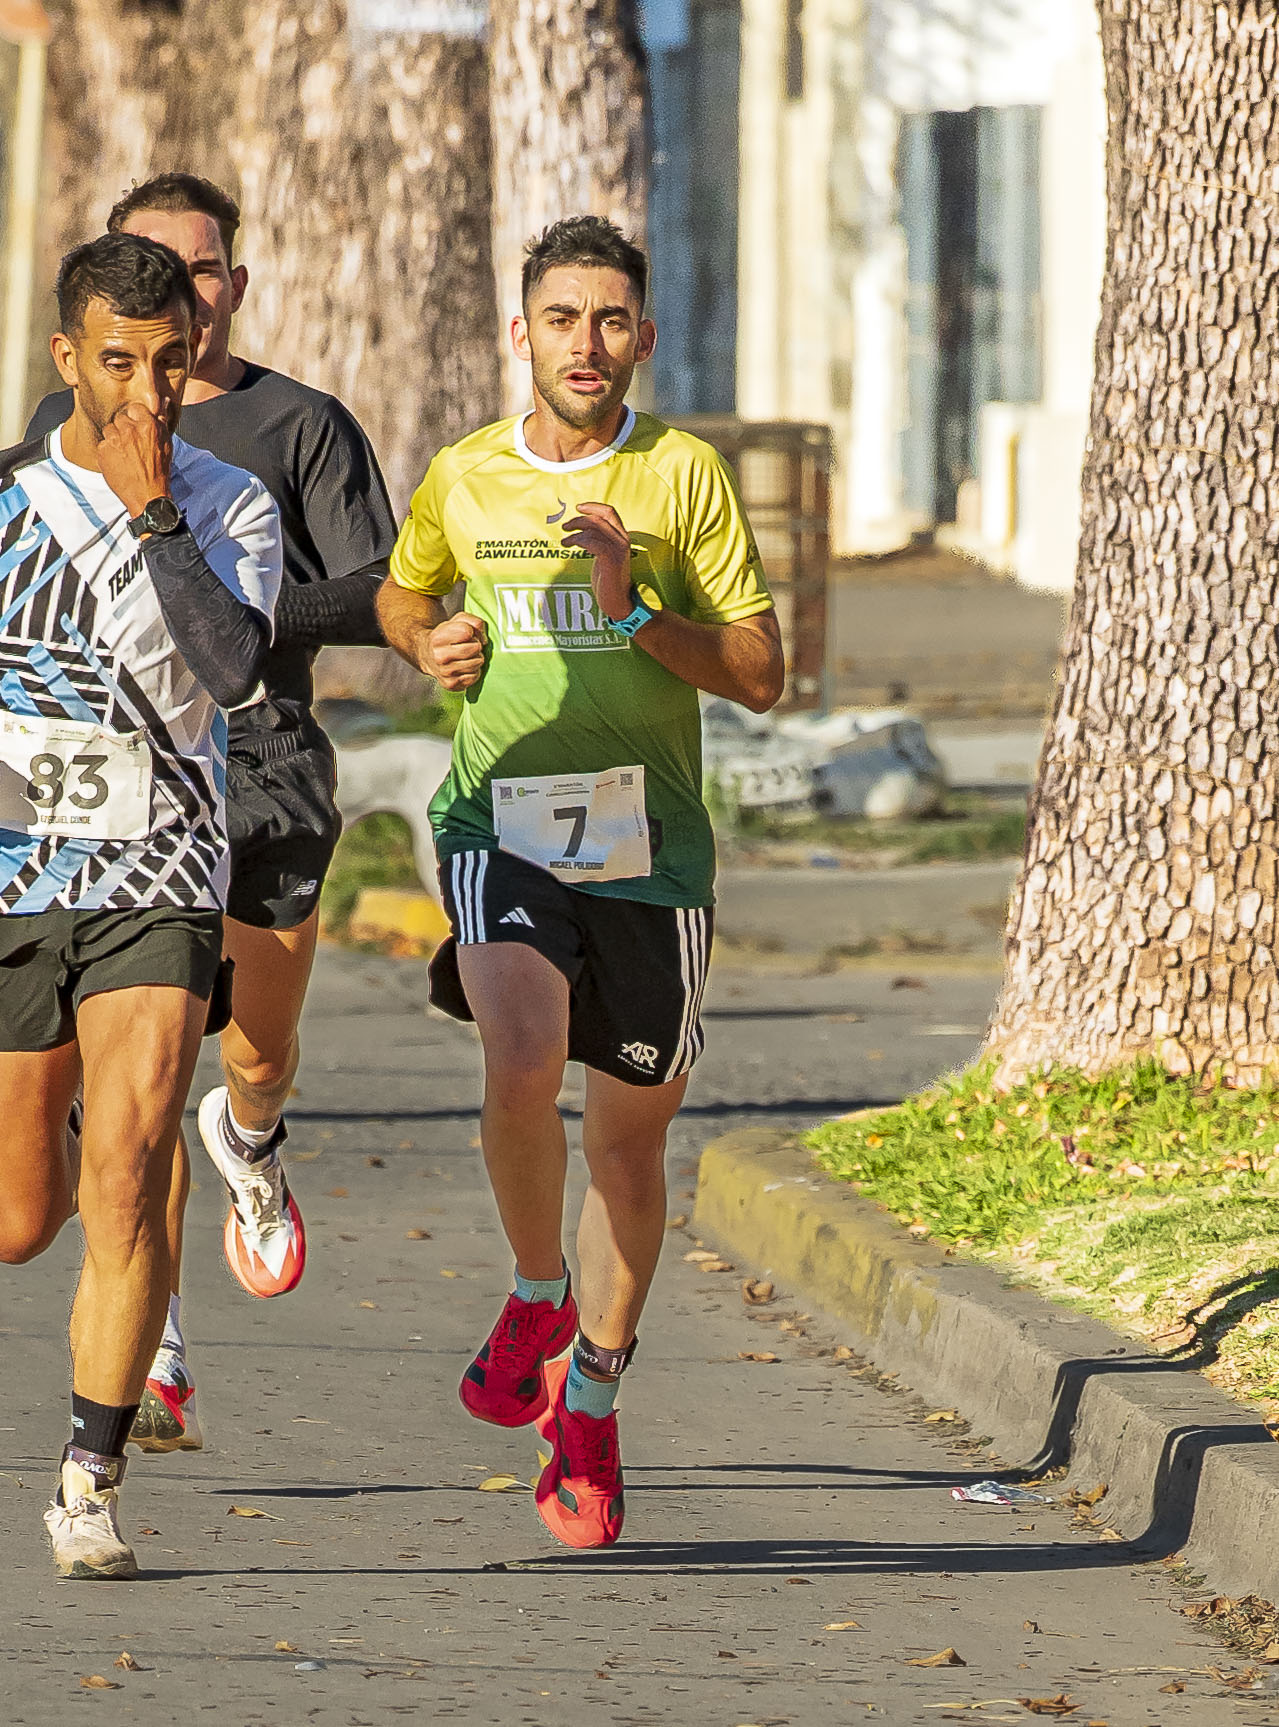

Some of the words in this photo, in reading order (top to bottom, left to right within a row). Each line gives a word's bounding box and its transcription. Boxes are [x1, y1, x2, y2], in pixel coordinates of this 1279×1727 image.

[485, 539, 549, 548] MARATÓN
[108, 548, 143, 602] TEAM
[26, 753, 109, 809] 83
[553, 806, 588, 858] 7
